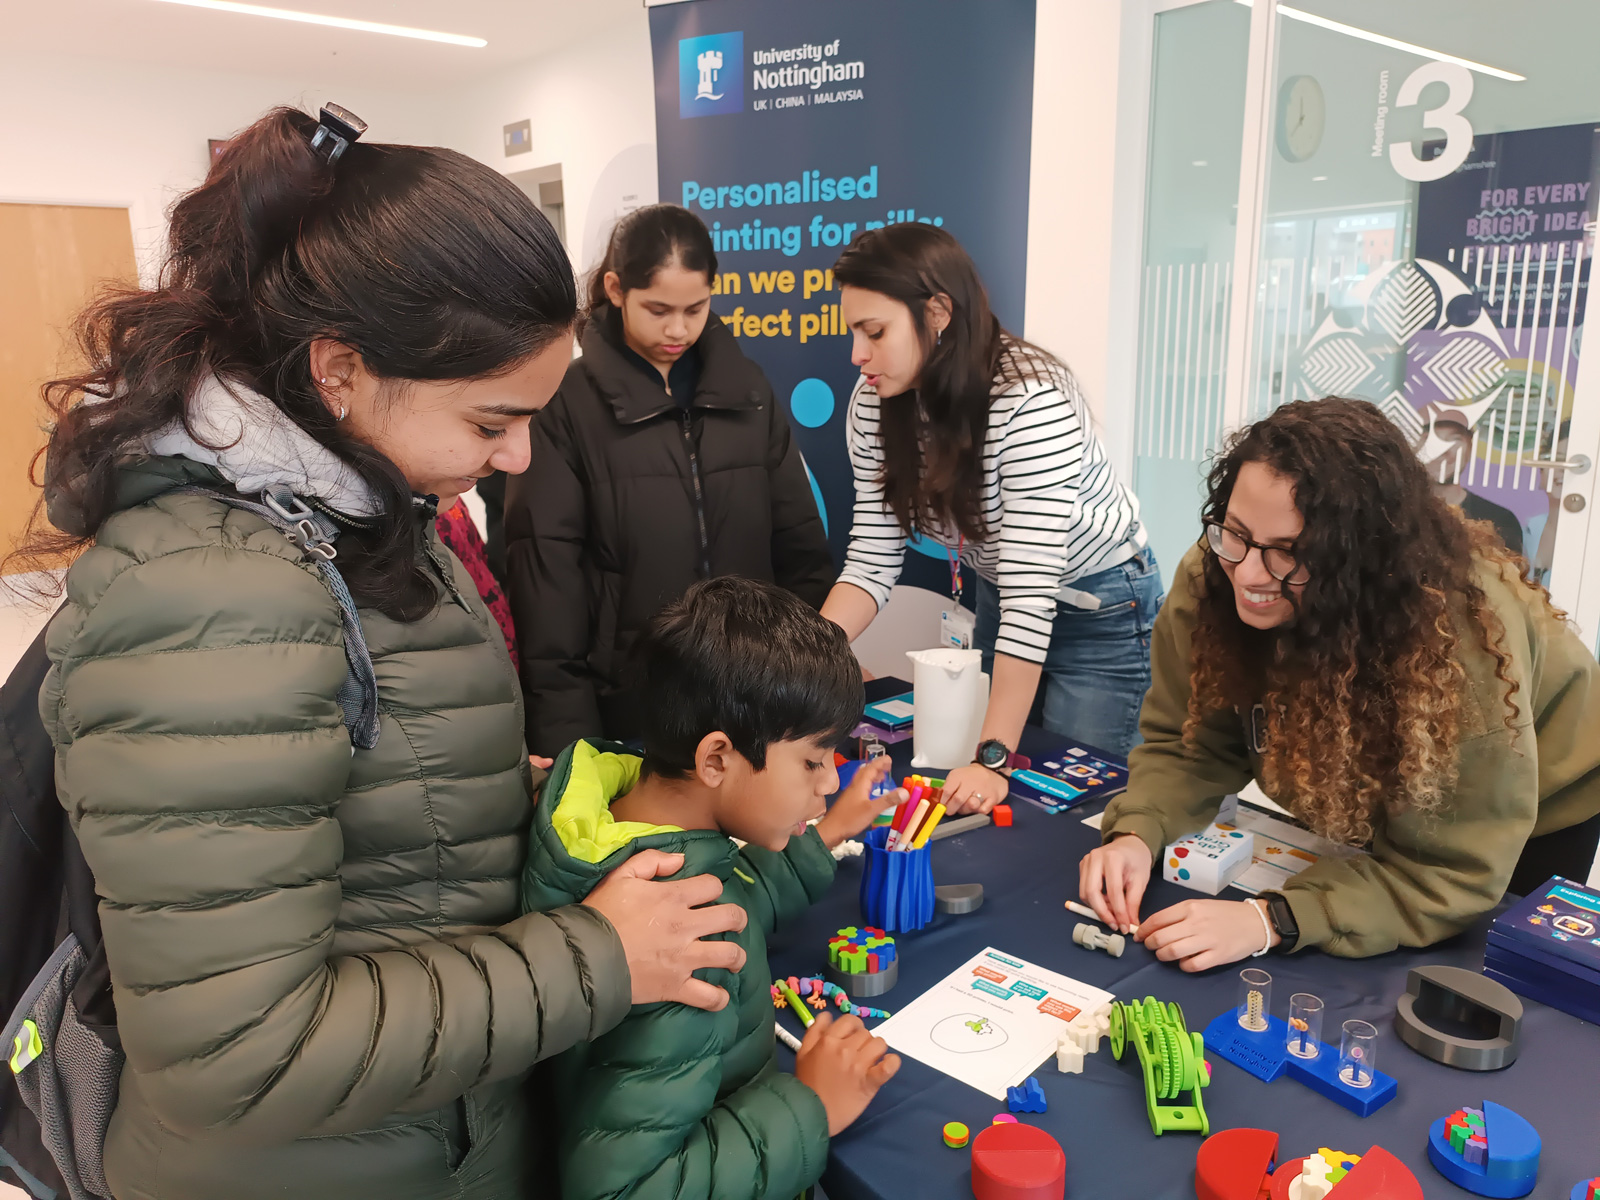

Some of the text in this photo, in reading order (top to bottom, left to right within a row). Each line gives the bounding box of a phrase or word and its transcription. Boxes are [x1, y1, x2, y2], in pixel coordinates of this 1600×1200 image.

[753, 39, 840, 66] University of
[753, 61, 864, 90] Nottingham
[753, 89, 864, 111] UK CHINA MALAYSIA
[1371, 70, 1389, 157] Meeting room
[1389, 61, 1474, 182] 3
[682, 165, 878, 210] Personalised
[1480, 182, 1591, 208] FOR EVERY
[708, 219, 801, 257] inting
[809, 215, 857, 247] for
[1466, 214, 1539, 237] BRIGHT
[710, 272, 741, 295] an
[748, 270, 795, 293] we
[720, 306, 792, 337] rfect
[1194, 834, 1230, 848] Grab
[1198, 841, 1225, 853] Lab
[1229, 1047, 1269, 1073] Nottingham
[1233, 1039, 1267, 1061] University
